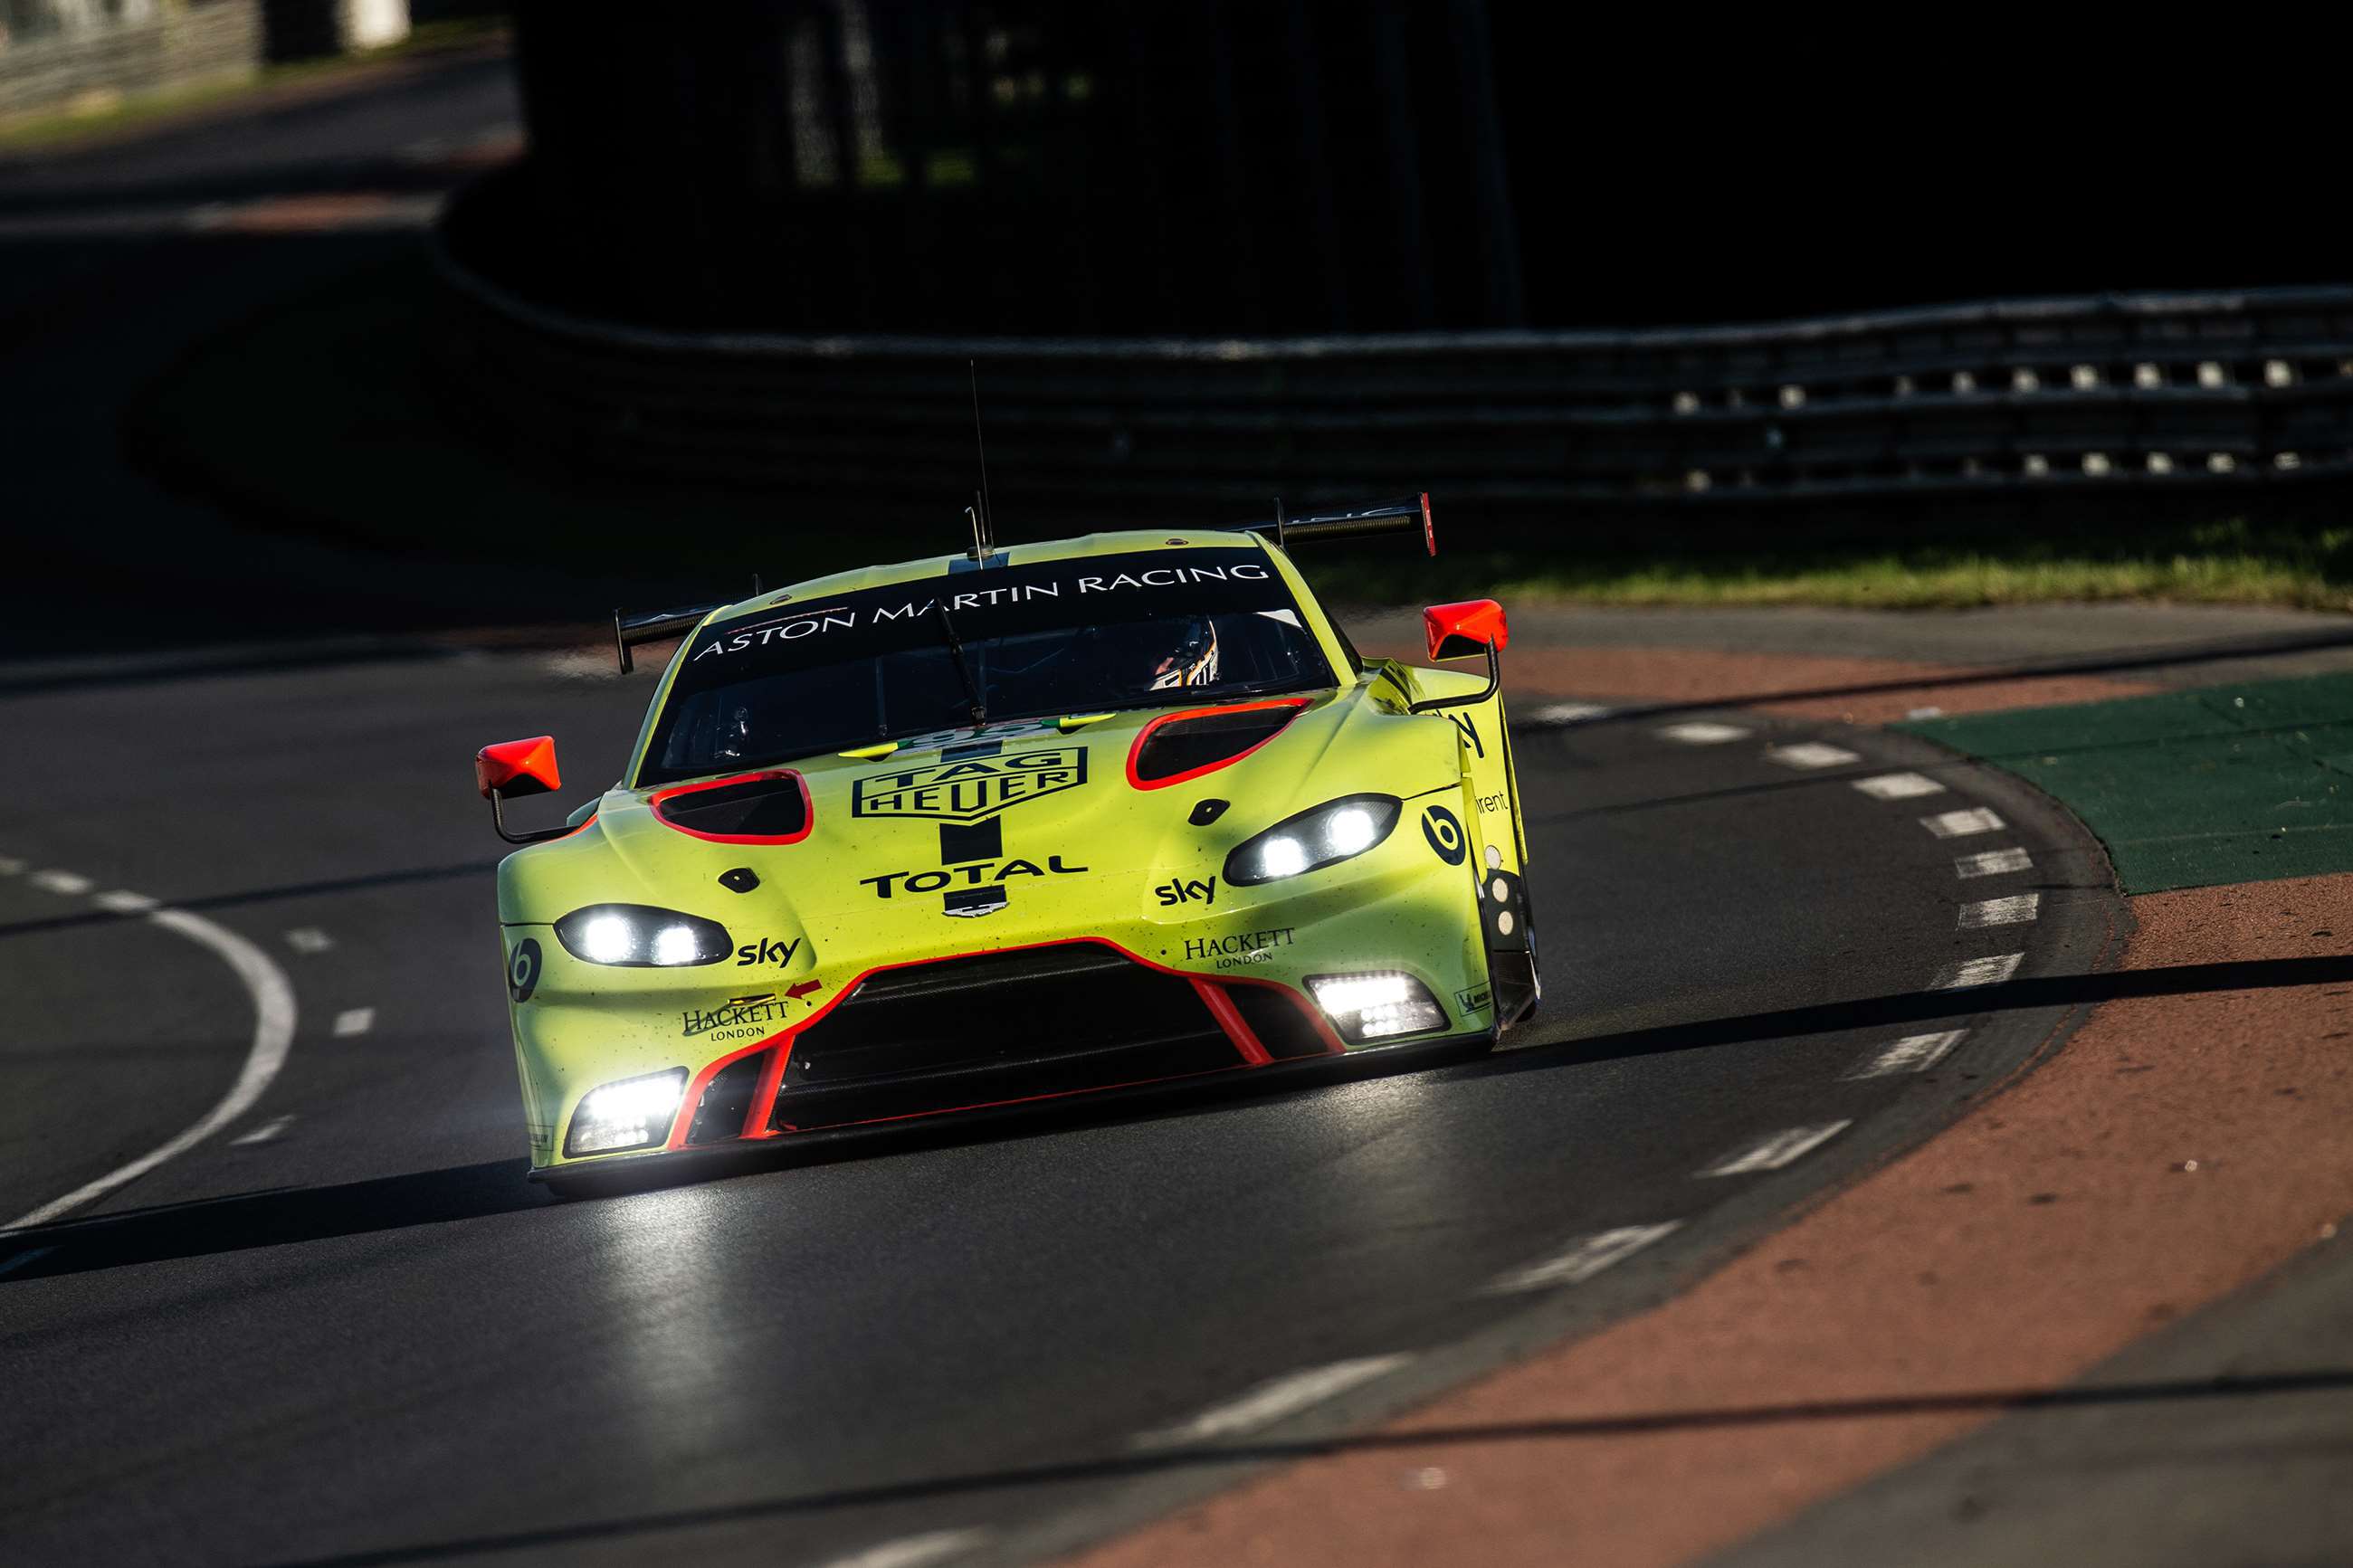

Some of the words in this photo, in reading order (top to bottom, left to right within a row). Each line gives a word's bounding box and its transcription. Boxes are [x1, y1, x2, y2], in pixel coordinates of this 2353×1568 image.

[693, 612, 855, 660] ASTON
[872, 582, 1058, 623] MARTIN
[1078, 565, 1269, 594] RACING
[875, 752, 1062, 788] TAG
[871, 771, 1069, 813] HEUER
[860, 855, 1089, 898] TOTAL
[1155, 876, 1216, 906] sky
[737, 937, 801, 968] sky
[1184, 927, 1295, 960] HACKETT
[1216, 953, 1273, 969] LONDON
[682, 1001, 789, 1032] HACKETT
[710, 1026, 765, 1041] LONDON
